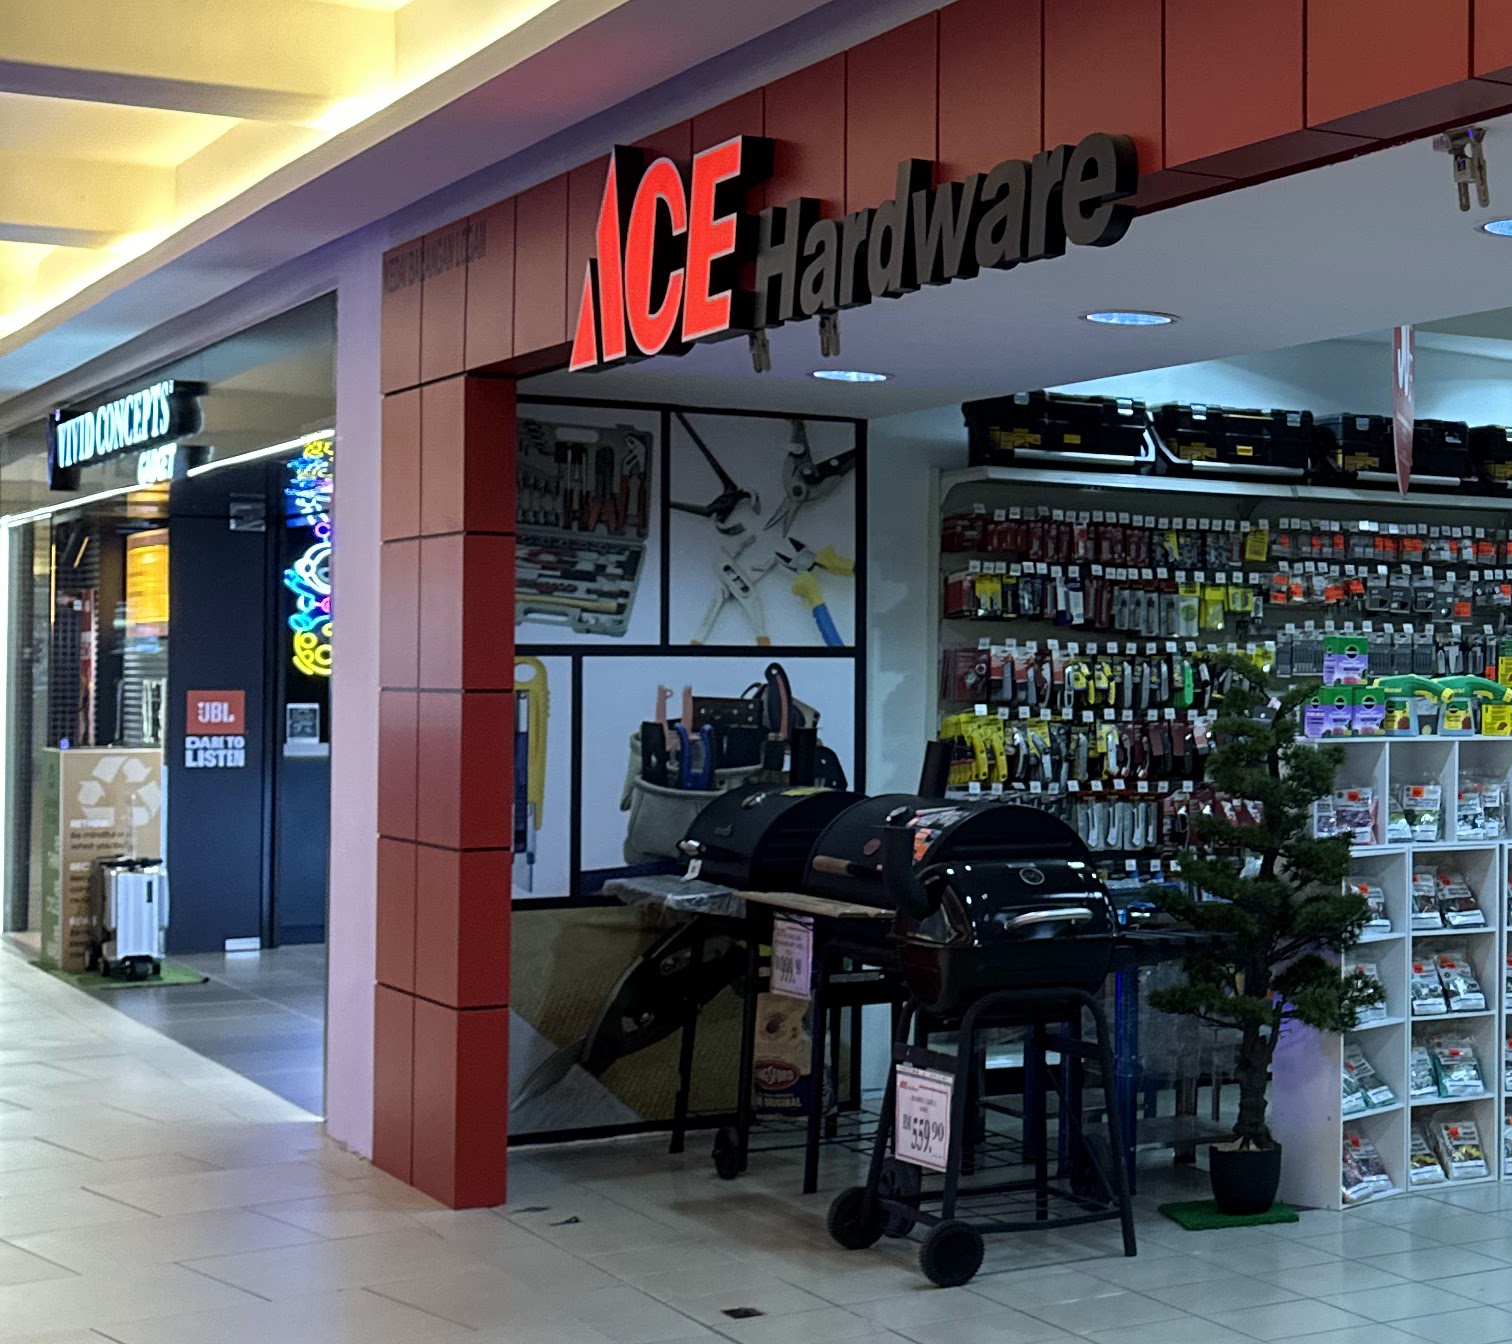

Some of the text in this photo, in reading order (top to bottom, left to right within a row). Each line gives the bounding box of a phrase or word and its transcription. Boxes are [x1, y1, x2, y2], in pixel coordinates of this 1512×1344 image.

[568, 133, 1134, 373] ACE Hardware
[57, 380, 171, 468] VIVID CONCEPTS
[198, 701, 236, 724] JBL
[226, 736, 246, 750] TO
[185, 749, 246, 768] LISTEN
